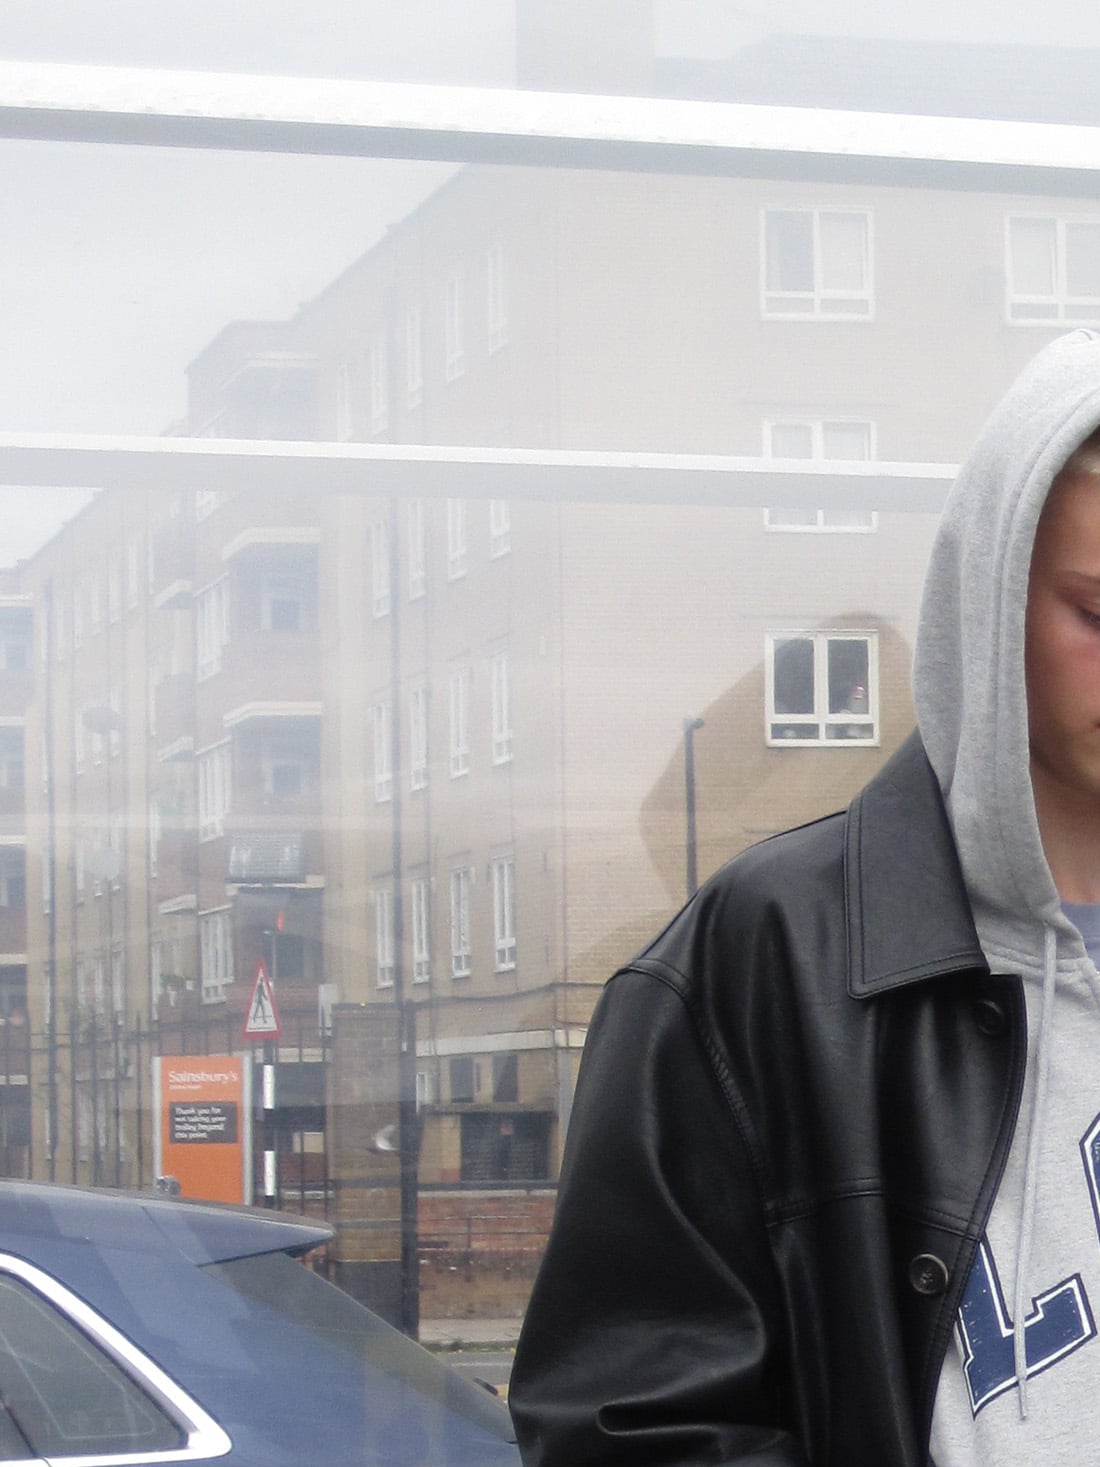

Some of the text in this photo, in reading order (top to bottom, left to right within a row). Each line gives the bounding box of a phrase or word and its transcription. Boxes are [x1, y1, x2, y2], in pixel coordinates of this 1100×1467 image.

[168, 1070, 238, 1084] Sainsbury's
[196, 1108, 210, 1117] you
[211, 1106, 221, 1114] for
